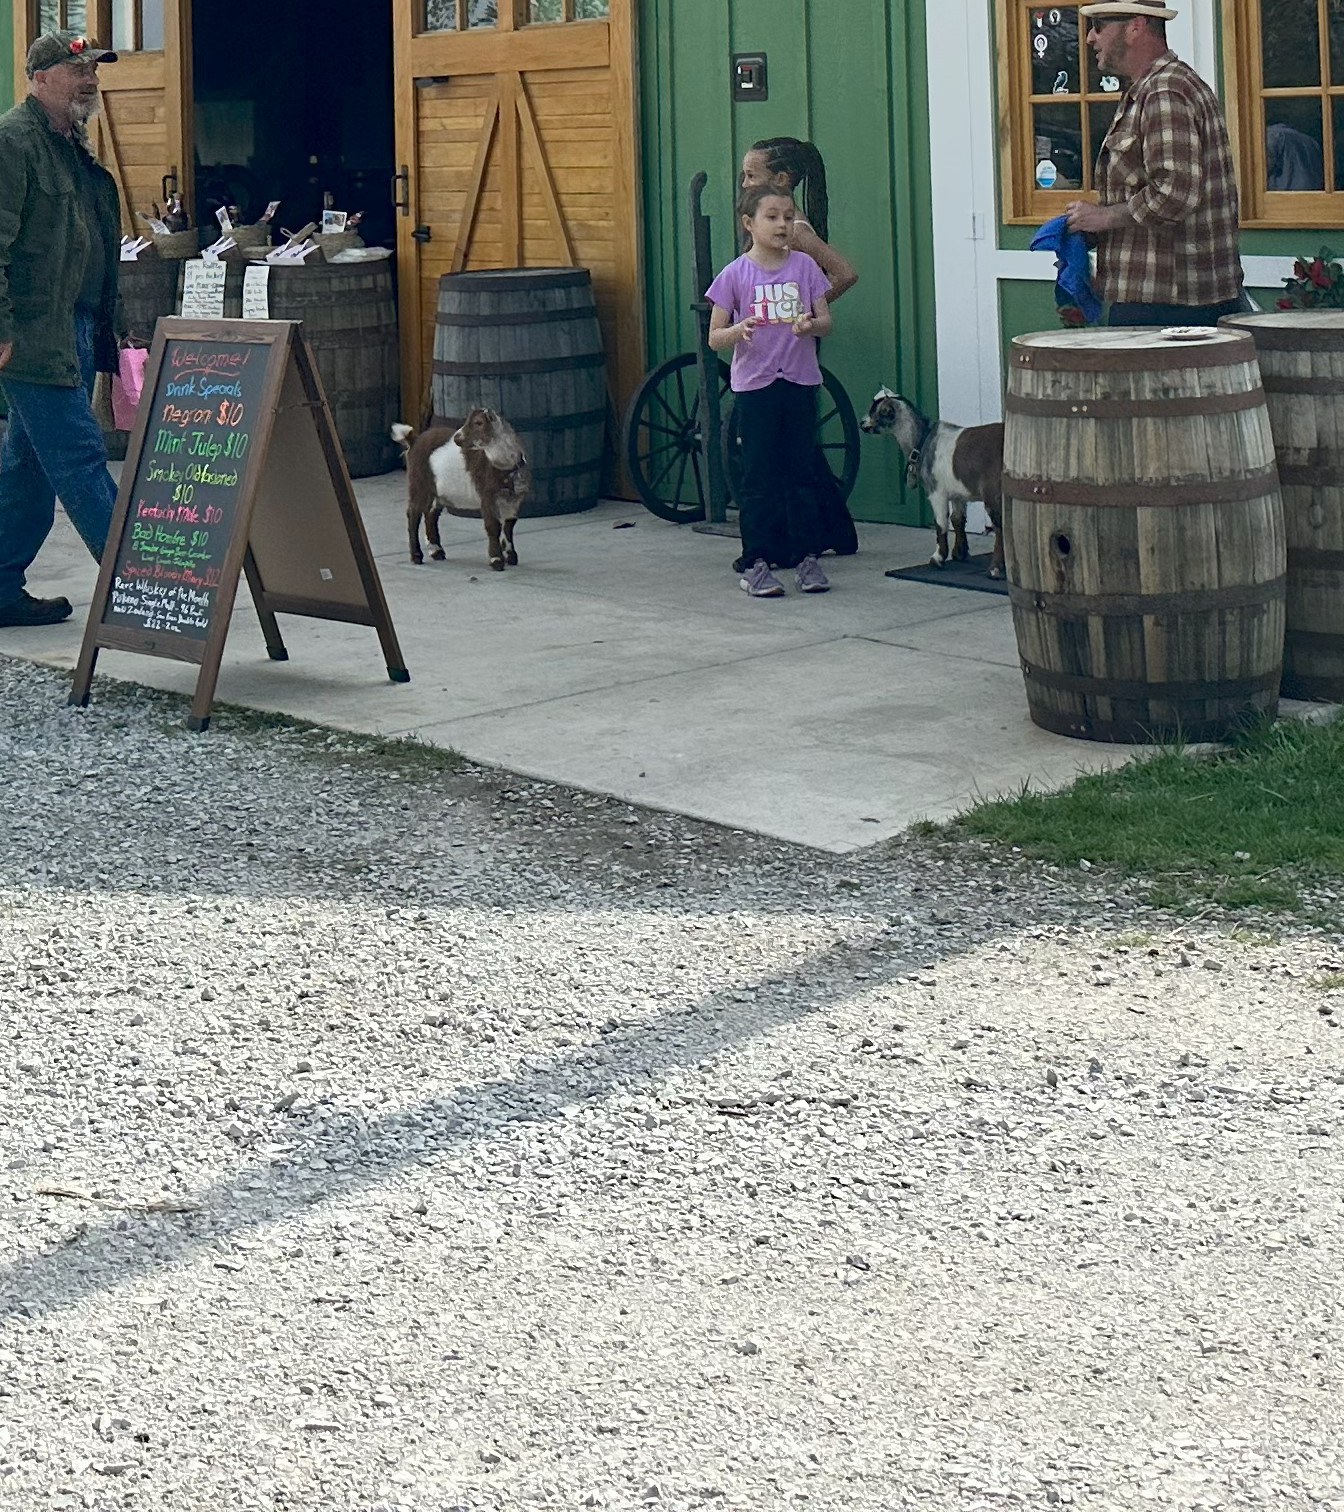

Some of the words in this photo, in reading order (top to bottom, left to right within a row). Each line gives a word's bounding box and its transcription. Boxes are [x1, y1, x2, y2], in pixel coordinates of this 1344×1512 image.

[754, 282, 799, 303] JUS
[172, 345, 252, 367] Welcome!
[166, 375, 196, 397] Drink
[216, 398, 245, 427] $10
[154, 428, 187, 455] Mint
[188, 431, 223, 462] Julep
[223, 431, 249, 459] $10
[172, 484, 194, 504] $10
[202, 504, 223, 524] $10
[132, 522, 154, 540] Bad
[191, 530, 209, 547] $10
